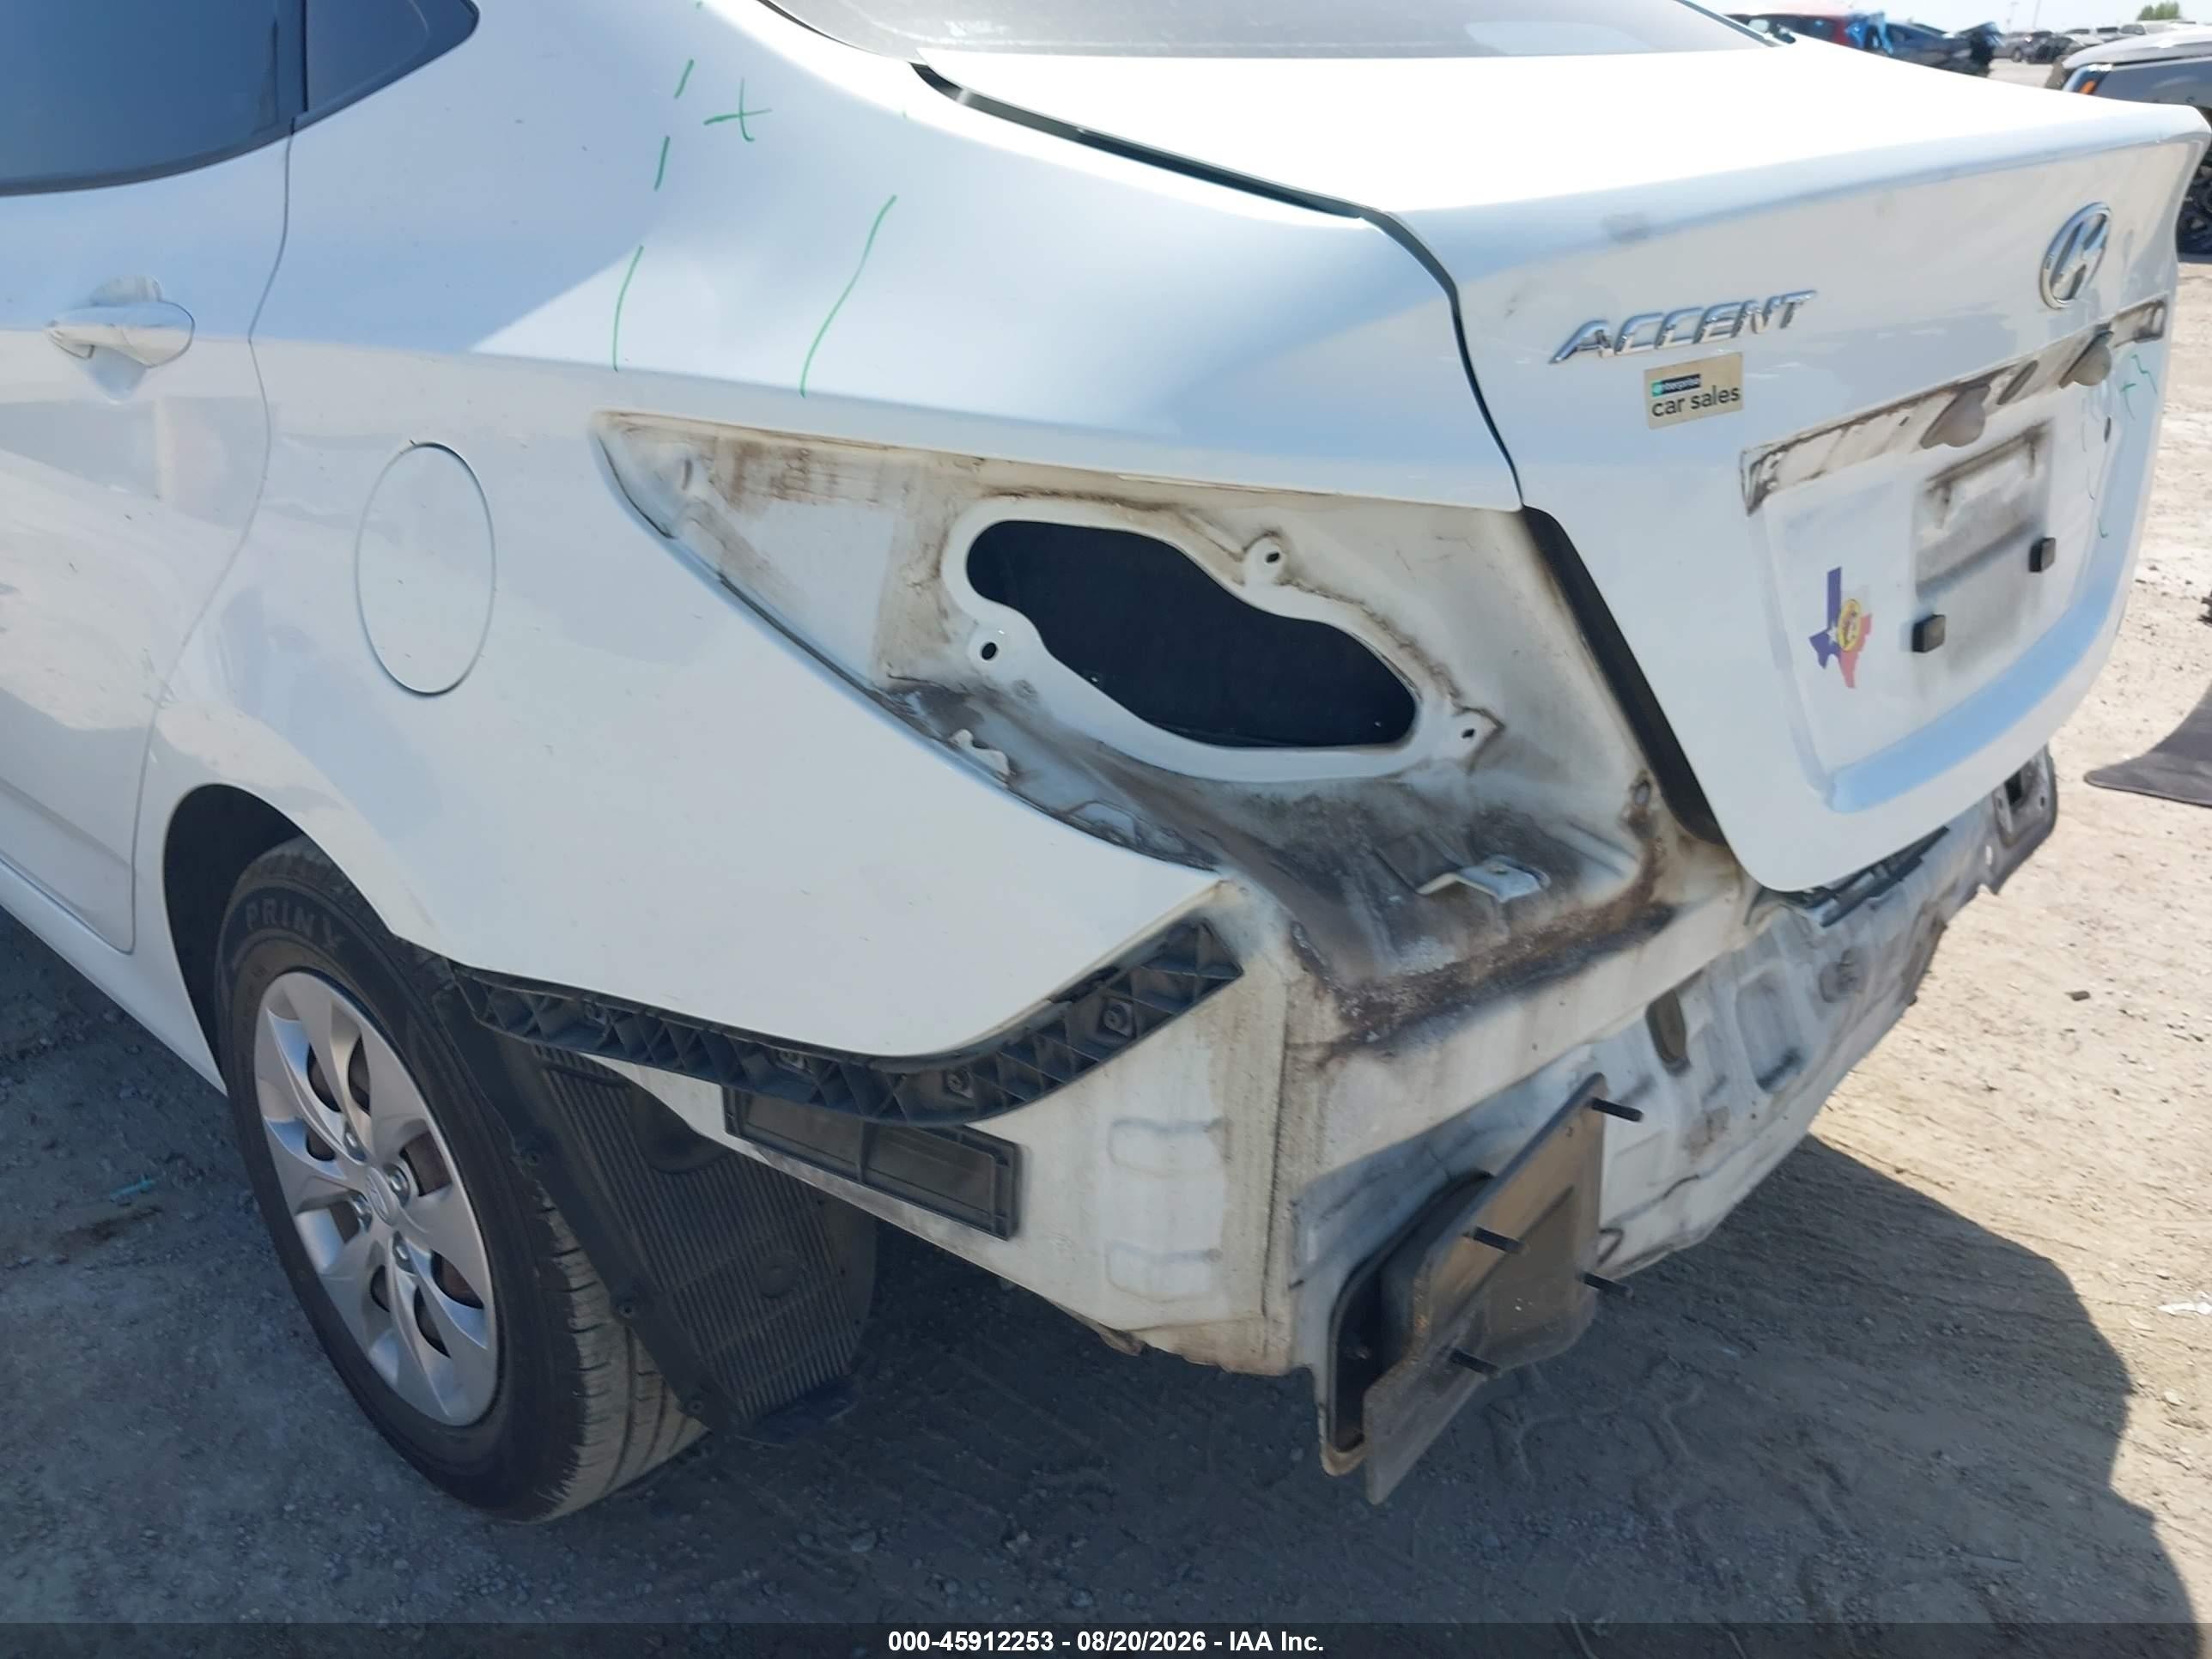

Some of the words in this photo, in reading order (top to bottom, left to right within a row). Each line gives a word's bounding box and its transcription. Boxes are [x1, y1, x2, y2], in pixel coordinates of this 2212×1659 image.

[1548, 289, 1817, 363] ACCENT
[1651, 398, 1685, 417] car
[1691, 385, 1741, 410] sales
